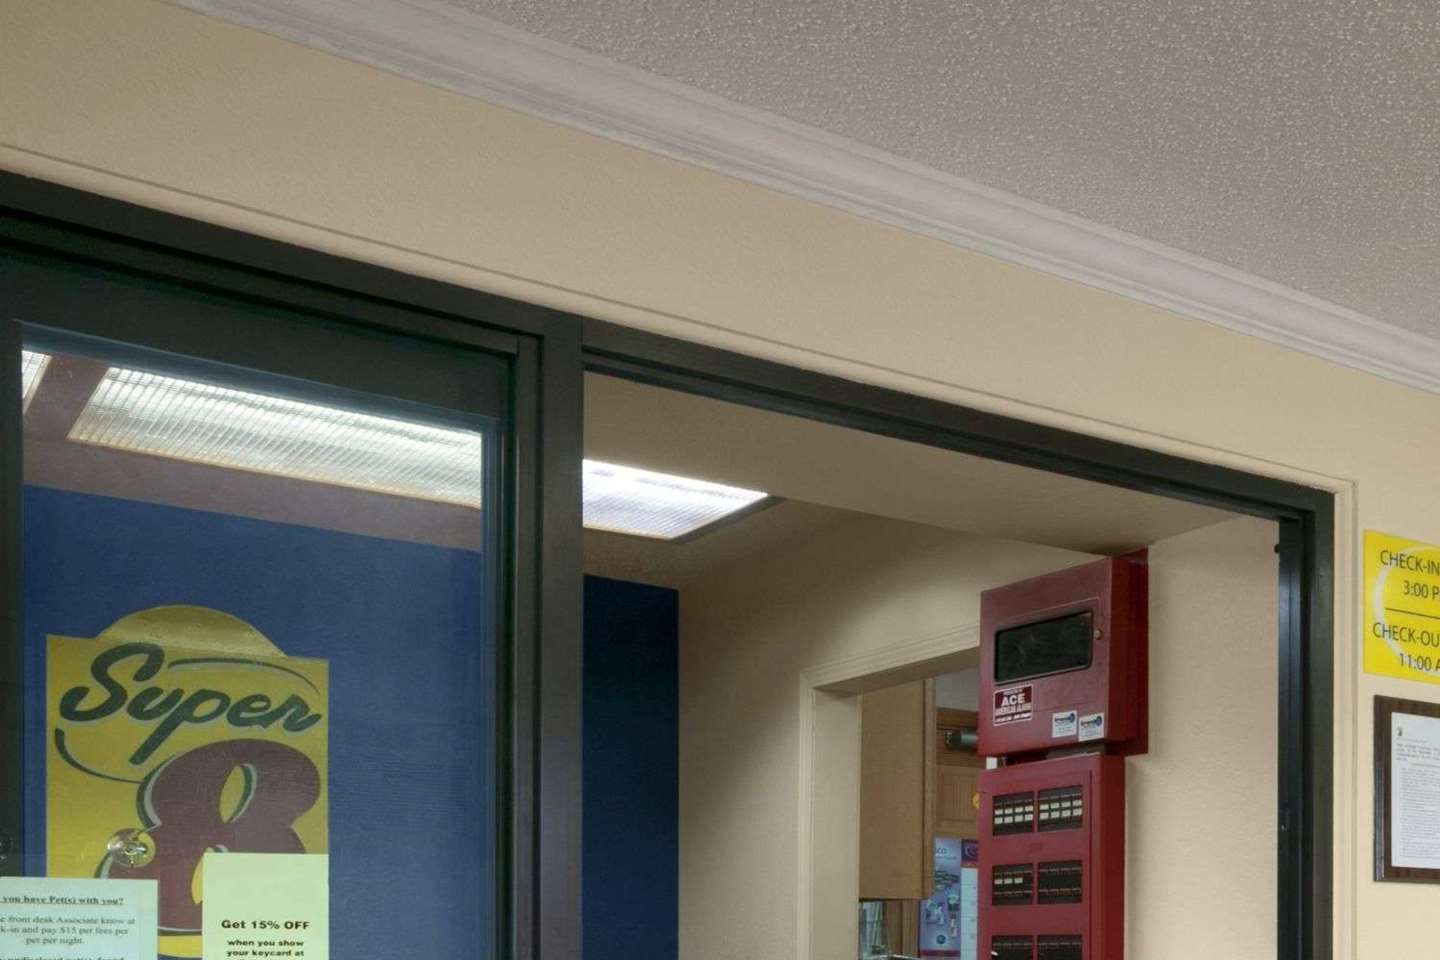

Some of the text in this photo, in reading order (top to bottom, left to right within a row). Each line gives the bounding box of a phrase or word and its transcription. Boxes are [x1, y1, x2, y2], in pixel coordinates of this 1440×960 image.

[1379, 549, 1440, 577] CHECK-IN
[1402, 580, 1429, 599] 3:00
[1399, 652, 1432, 672] 11:00
[59, 642, 322, 766] Super
[1001, 692, 1026, 707] ACE
[94, 738, 321, 936] 8
[24, 895, 46, 904] have
[79, 897, 99, 906] with
[101, 897, 124, 906] you?
[41, 927, 56, 935] pay
[221, 919, 310, 930] Get 15% OFF
[257, 940, 276, 948] you
[278, 939, 304, 947] show
[251, 949, 292, 957] keycard
